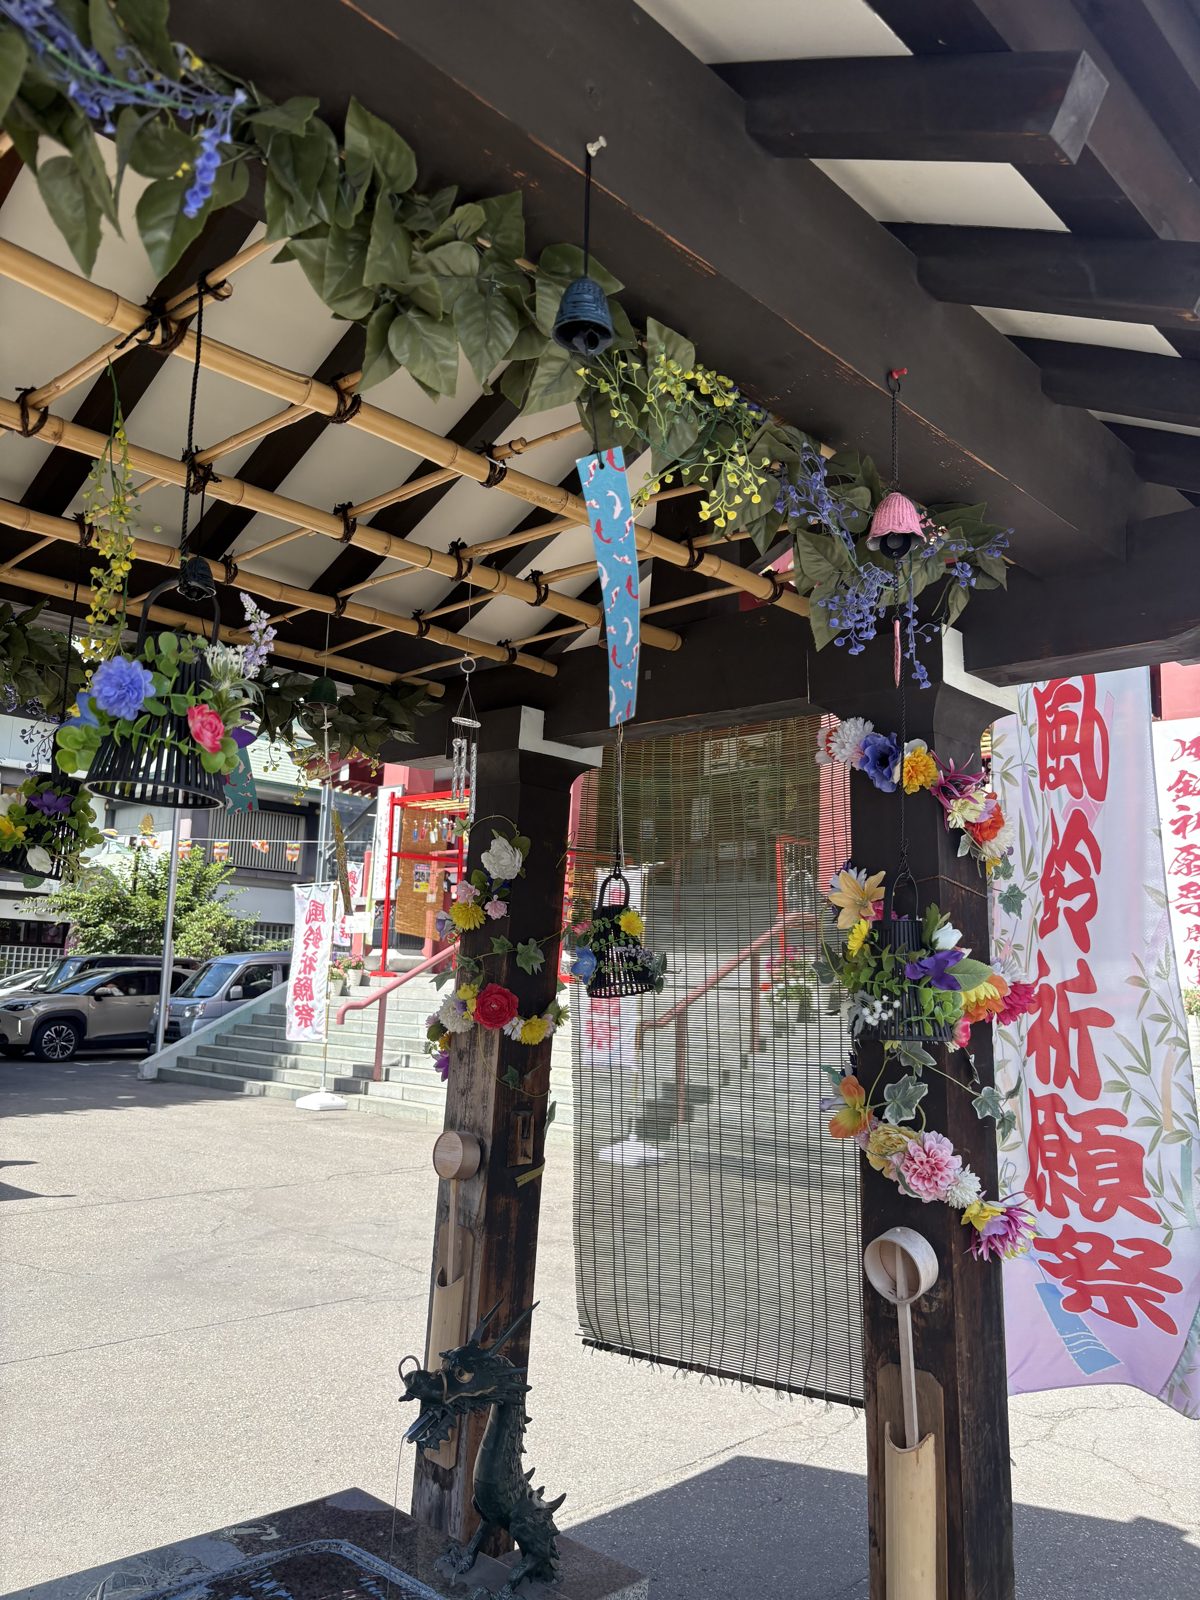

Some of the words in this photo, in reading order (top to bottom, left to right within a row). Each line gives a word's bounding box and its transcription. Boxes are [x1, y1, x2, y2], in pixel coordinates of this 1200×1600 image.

[1026, 673, 1183, 1335] 風鈴祈願祭
